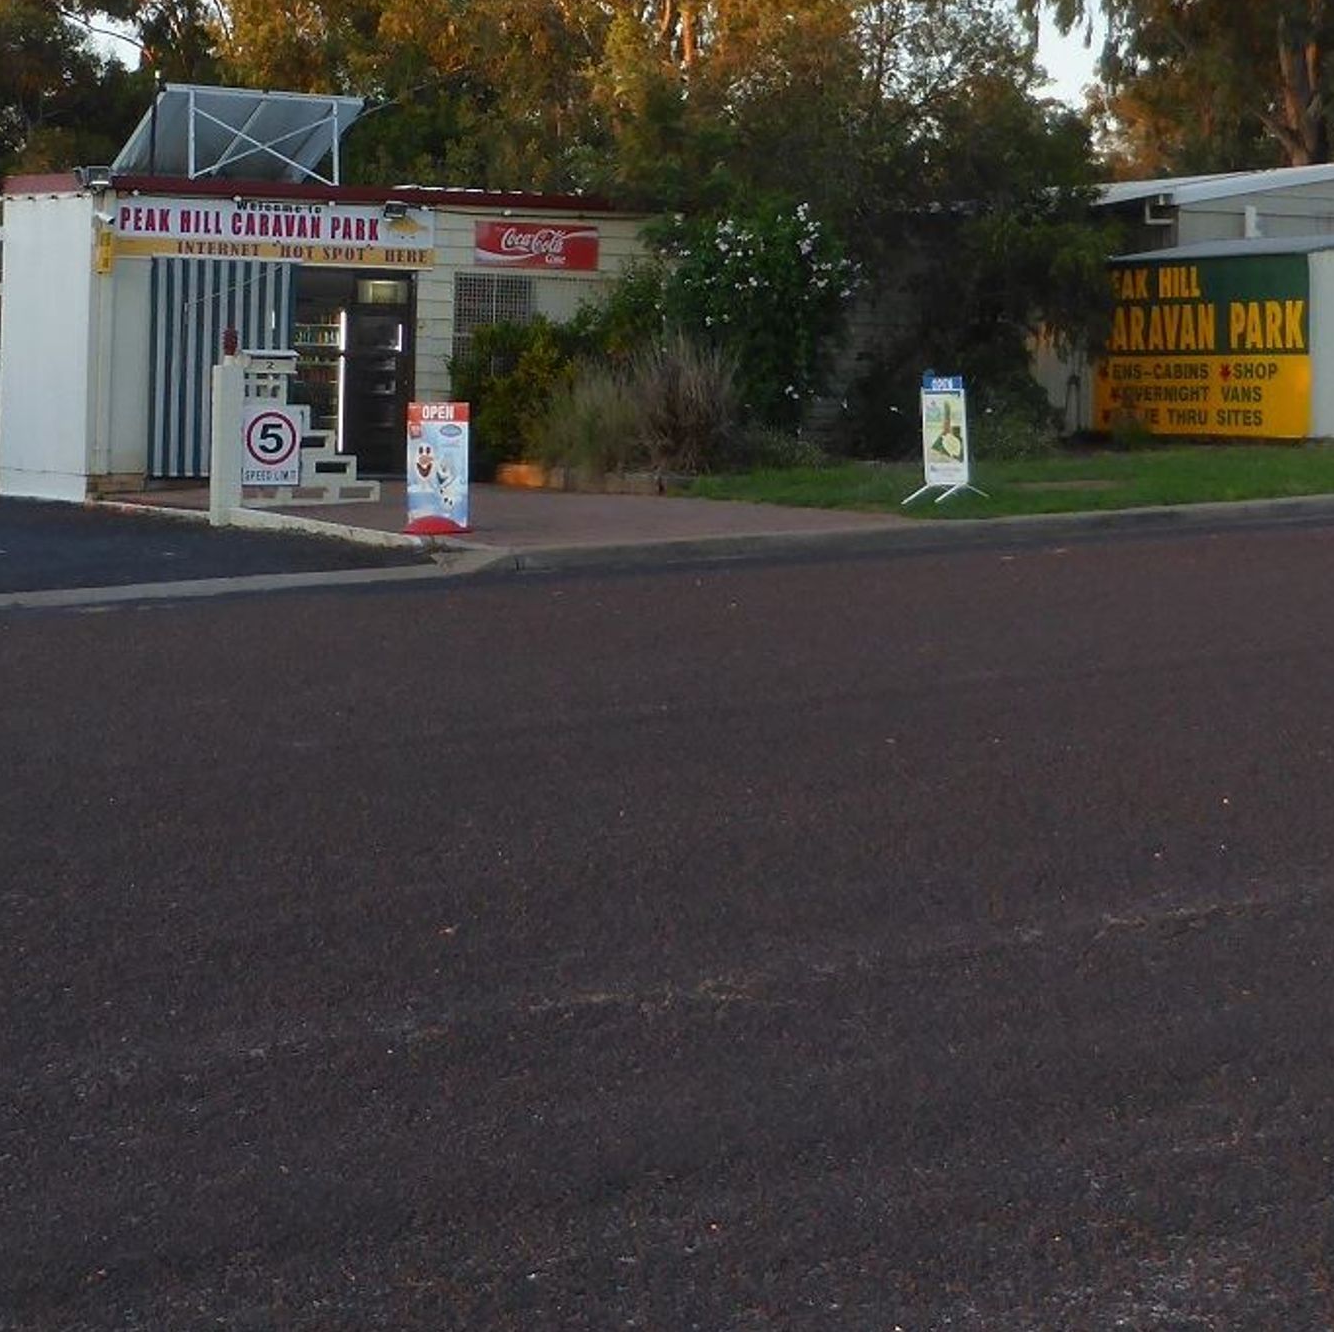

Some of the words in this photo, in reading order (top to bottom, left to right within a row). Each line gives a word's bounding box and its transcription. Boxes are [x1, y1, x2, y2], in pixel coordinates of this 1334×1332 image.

[236, 201, 303, 213] Welcome
[308, 205, 322, 214] to
[120, 206, 171, 233] PEAK
[180, 209, 222, 235] HILL
[231, 212, 322, 239] CARAVAN
[330, 216, 380, 242] PARK
[178, 240, 261, 257] INTERNET
[385, 249, 428, 264] HERE
[1113, 268, 1149, 300] EAK
[1158, 266, 1201, 298] HILL
[1106, 303, 1215, 351] ARAVAN
[1230, 300, 1305, 349] PARK
[1233, 362, 1278, 379] SHOP
[1222, 386, 1263, 403] VANS
[422, 405, 455, 420] OPEN
[1167, 409, 1209, 425] THRU
[1216, 409, 1264, 427] SITES
[258, 423, 284, 454] 5
[244, 469, 271, 481] SPEED
